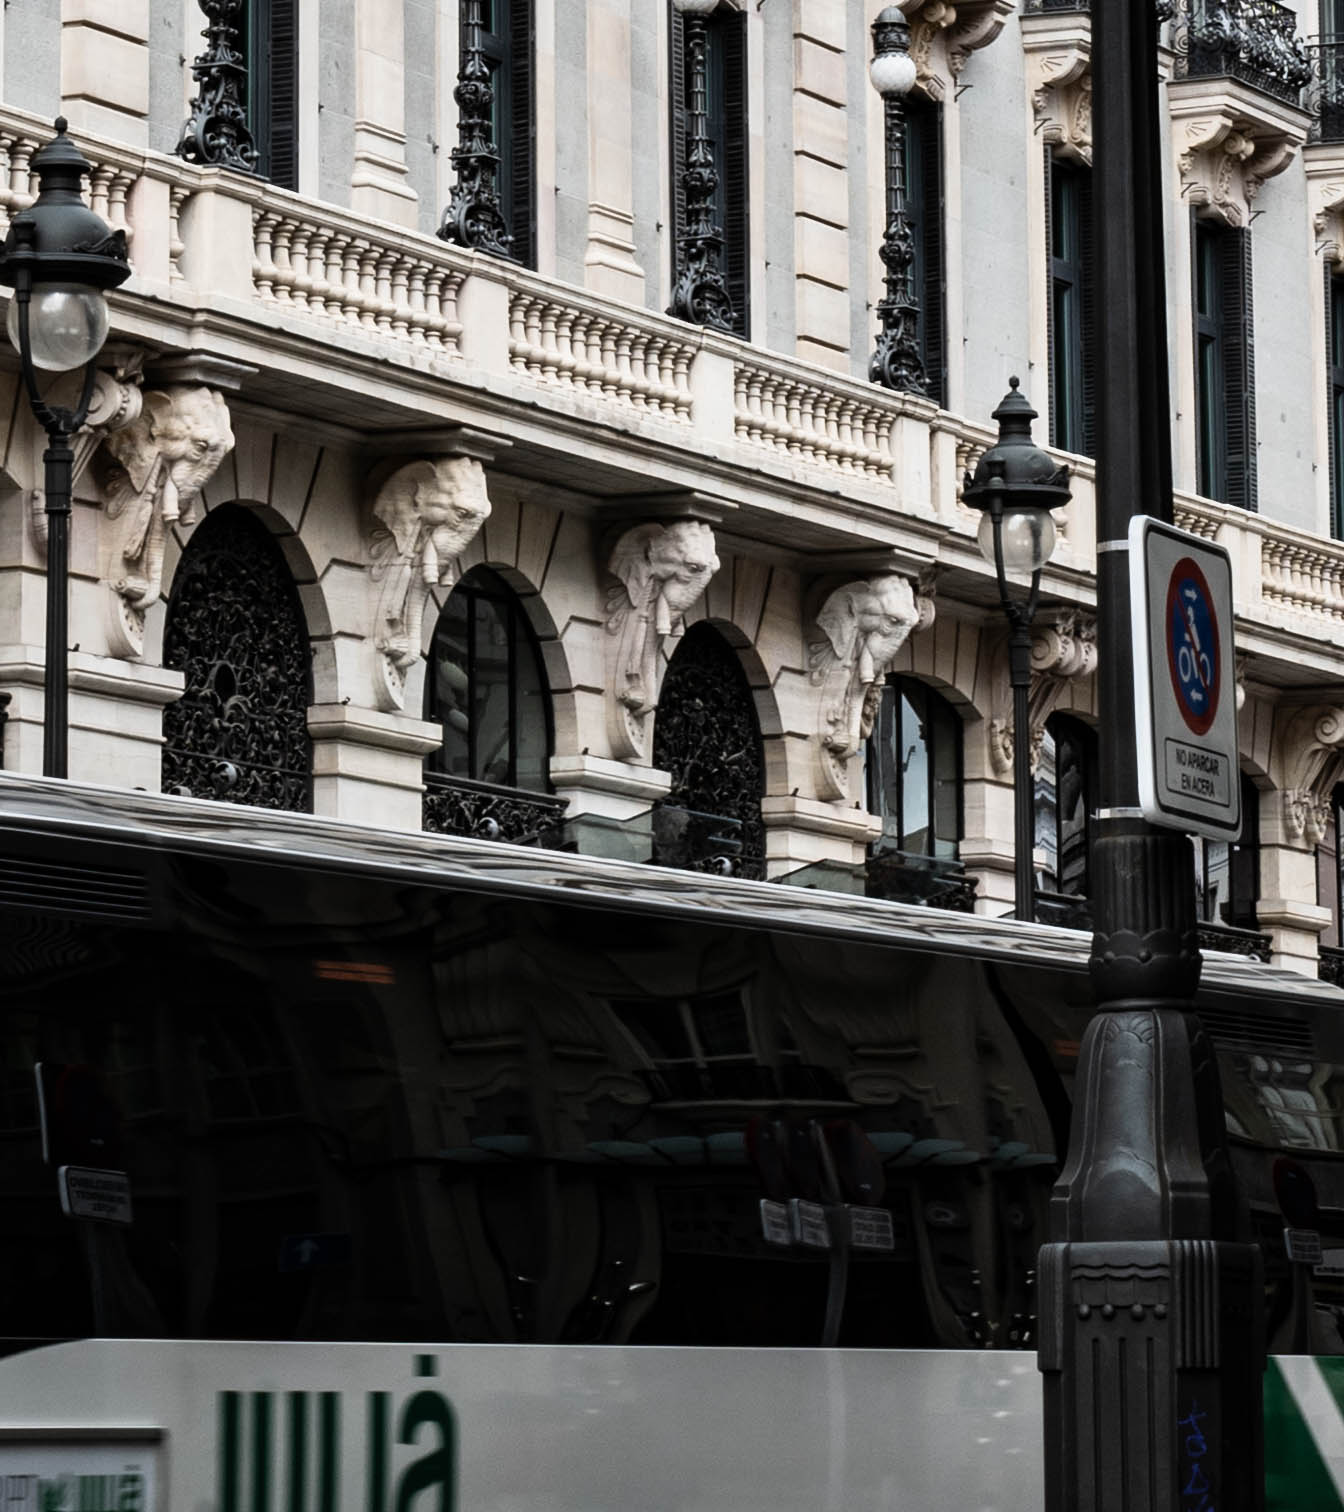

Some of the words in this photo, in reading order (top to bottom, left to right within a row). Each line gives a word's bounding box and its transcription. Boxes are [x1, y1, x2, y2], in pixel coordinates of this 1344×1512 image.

[1175, 747, 1187, 767] NO
[1188, 752, 1220, 777] APARCAR
[1181, 773, 1191, 791] EN
[1191, 777, 1216, 798] ACERA
